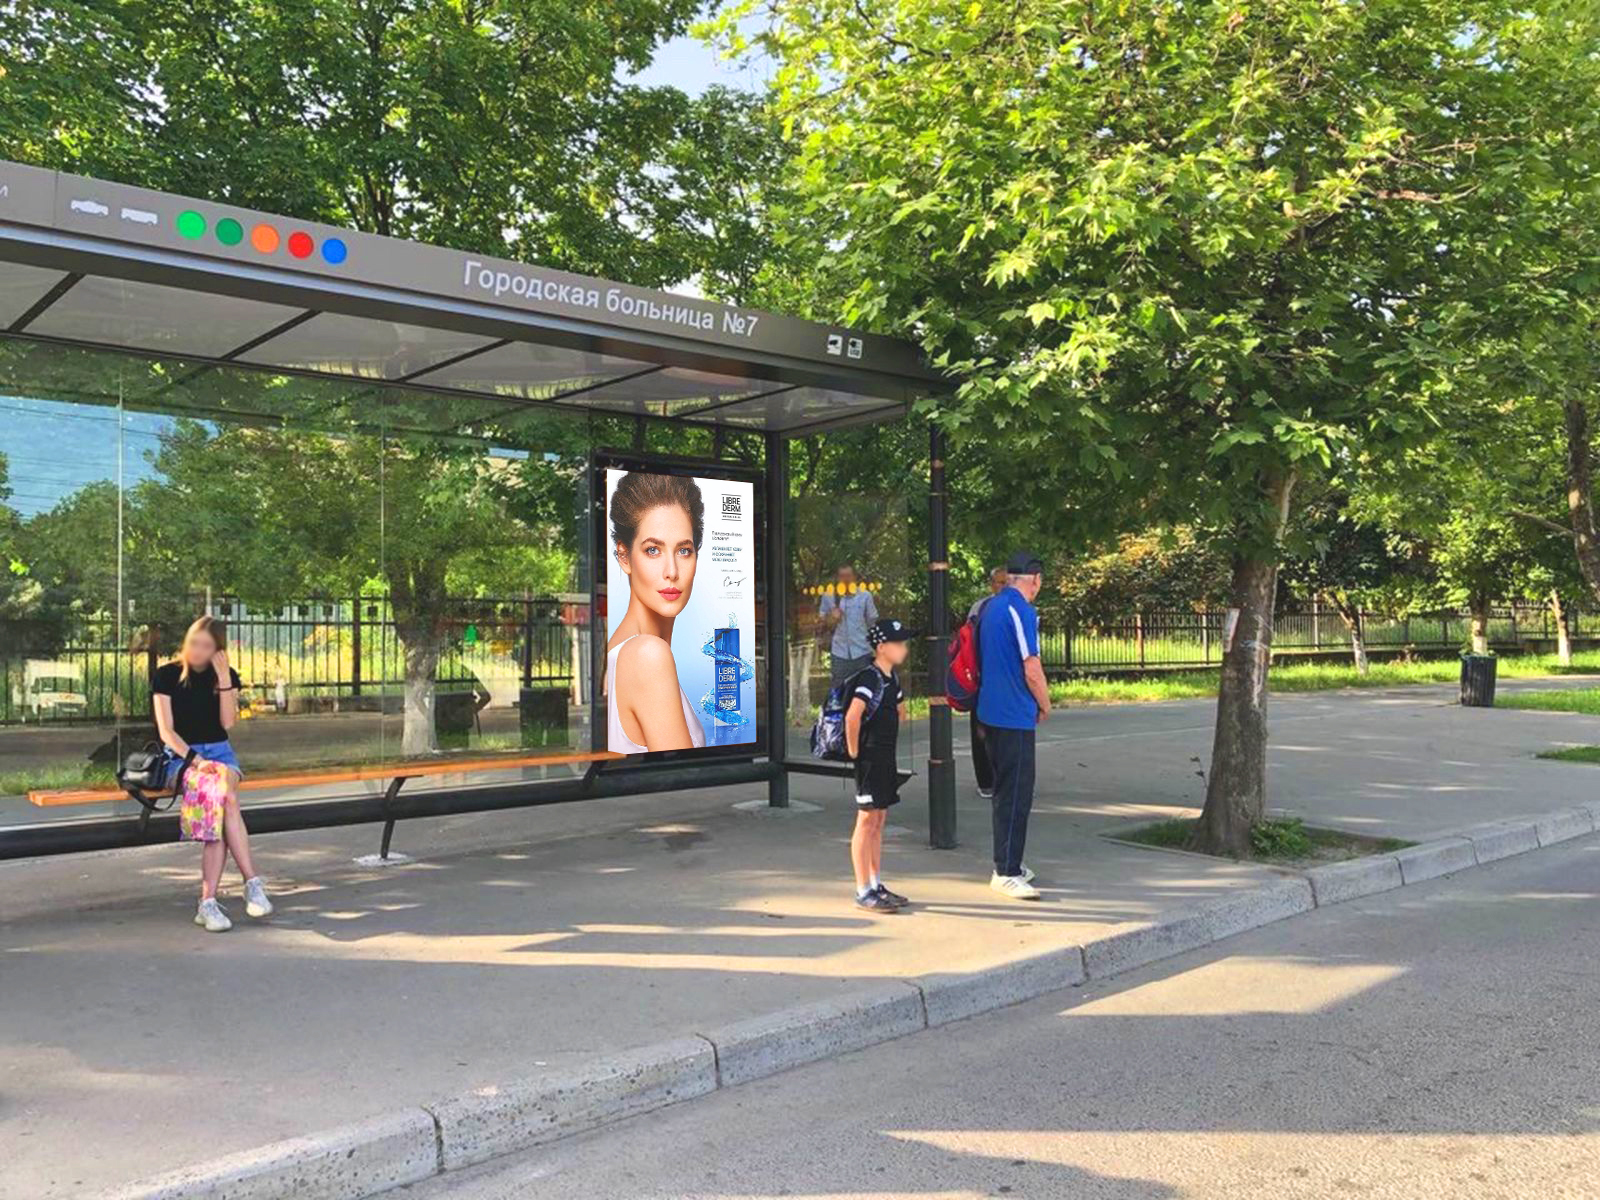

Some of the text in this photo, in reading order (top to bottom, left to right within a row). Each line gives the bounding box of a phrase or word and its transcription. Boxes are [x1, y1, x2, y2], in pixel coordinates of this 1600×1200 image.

[464, 260, 759, 337] Городская больница №7
[722, 496, 741, 505] LIBRE
[722, 504, 742, 512] DERM
[718, 674, 736, 682] DERM
